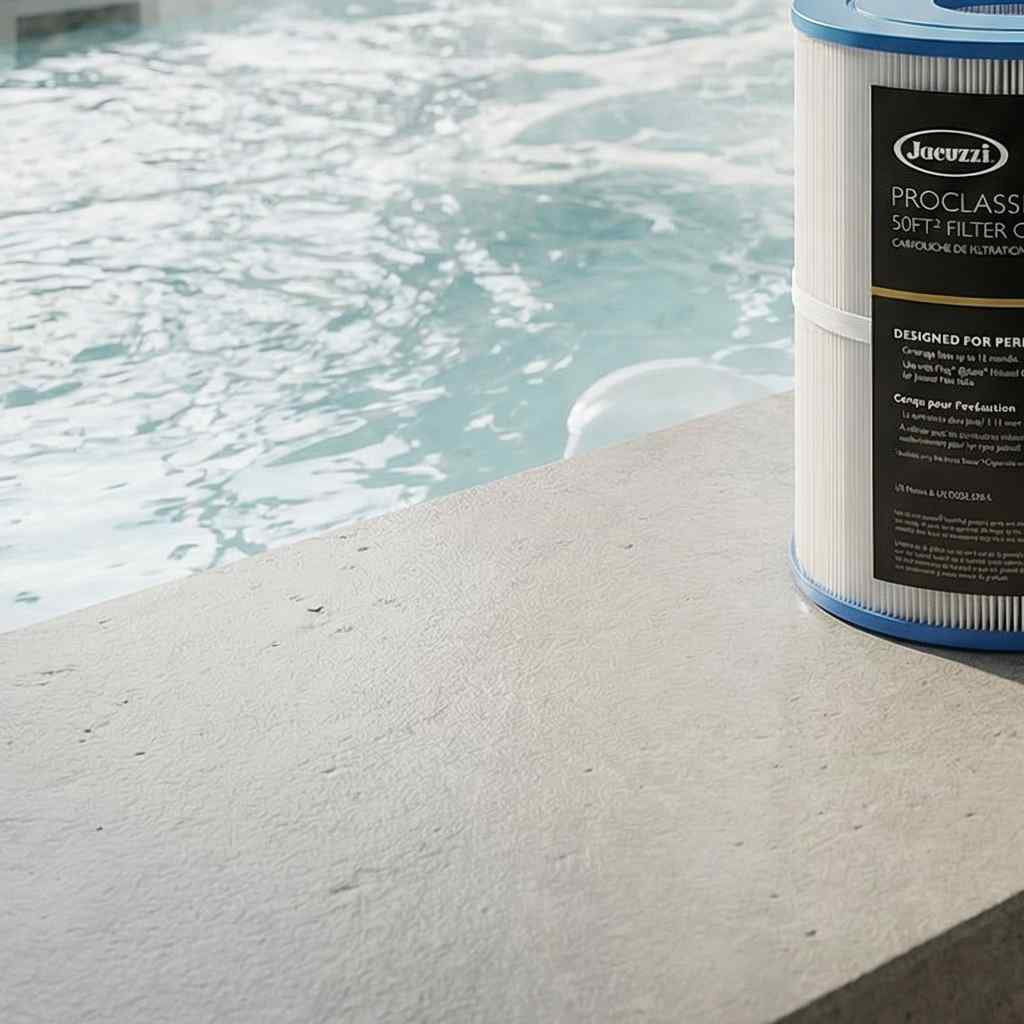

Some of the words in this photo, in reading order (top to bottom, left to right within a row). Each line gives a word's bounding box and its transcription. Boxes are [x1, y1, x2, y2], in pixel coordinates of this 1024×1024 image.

[906, 140, 991, 164] Jacuzzi
[947, 220, 1007, 239] FILTER
[894, 328, 960, 346] DESIGNED
